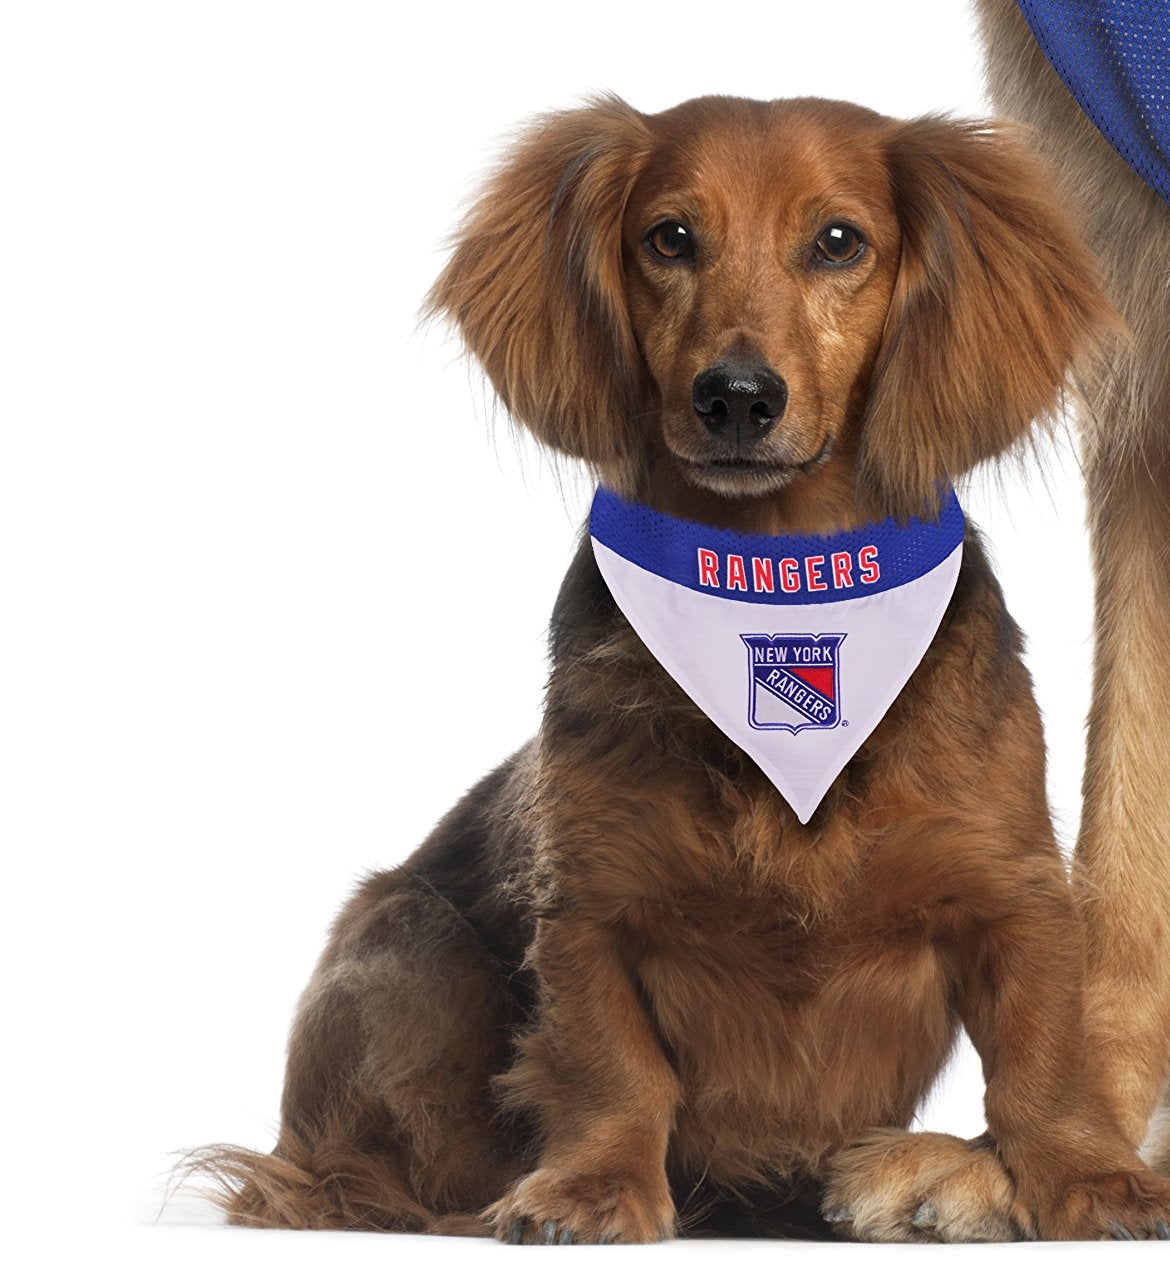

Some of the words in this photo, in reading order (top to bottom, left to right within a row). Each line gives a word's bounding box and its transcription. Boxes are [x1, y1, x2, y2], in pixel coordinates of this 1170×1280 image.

[697, 545, 881, 594] RANGERS
[754, 646, 788, 663] NEW
[793, 646, 833, 662] YORK
[765, 668, 832, 721] RANGERS
